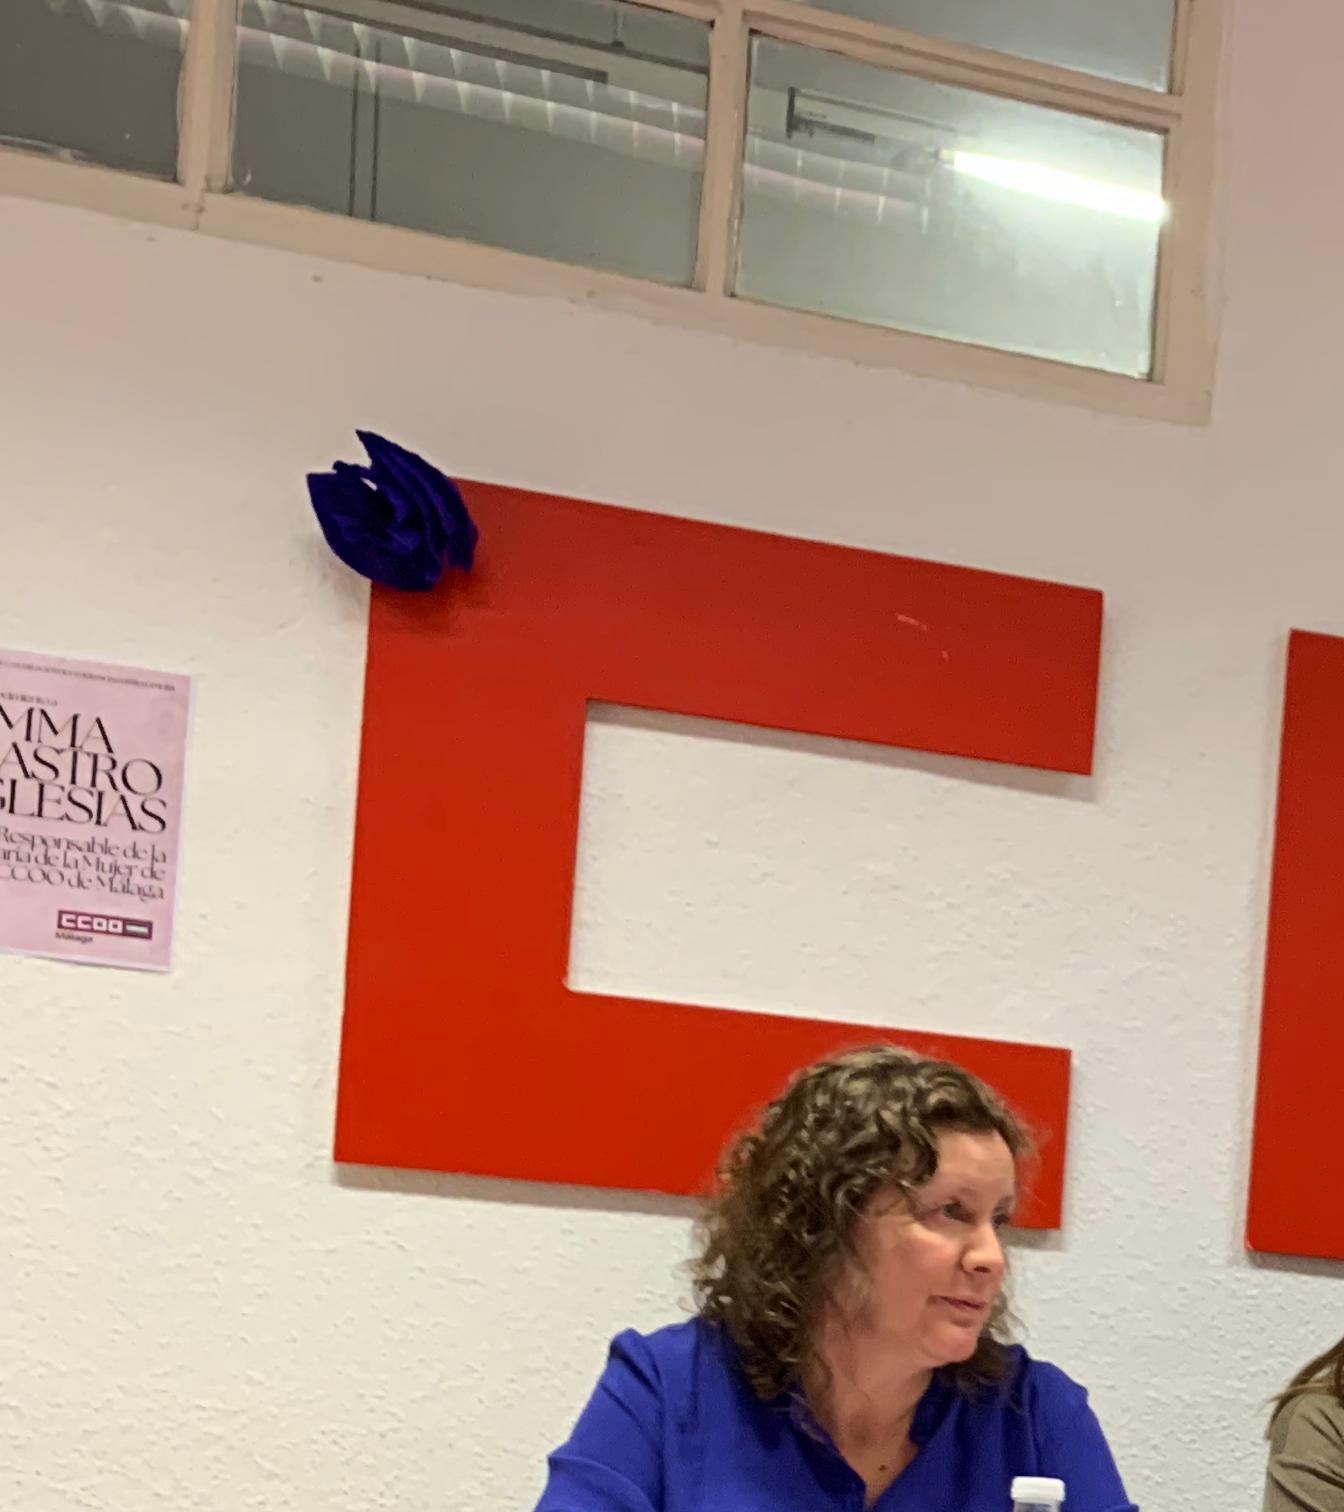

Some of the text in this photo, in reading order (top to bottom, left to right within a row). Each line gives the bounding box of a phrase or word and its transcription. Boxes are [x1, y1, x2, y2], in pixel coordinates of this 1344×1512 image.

[0, 704, 113, 754] MMA
[0, 742, 163, 796] ASTRO
[35, 848, 59, 867] de
[63, 851, 78, 870] la
[83, 855, 137, 879] Mujer
[123, 841, 147, 860] de
[152, 845, 167, 863] la
[68, 872, 92, 890] de
[61, 913, 123, 933] CCOO
